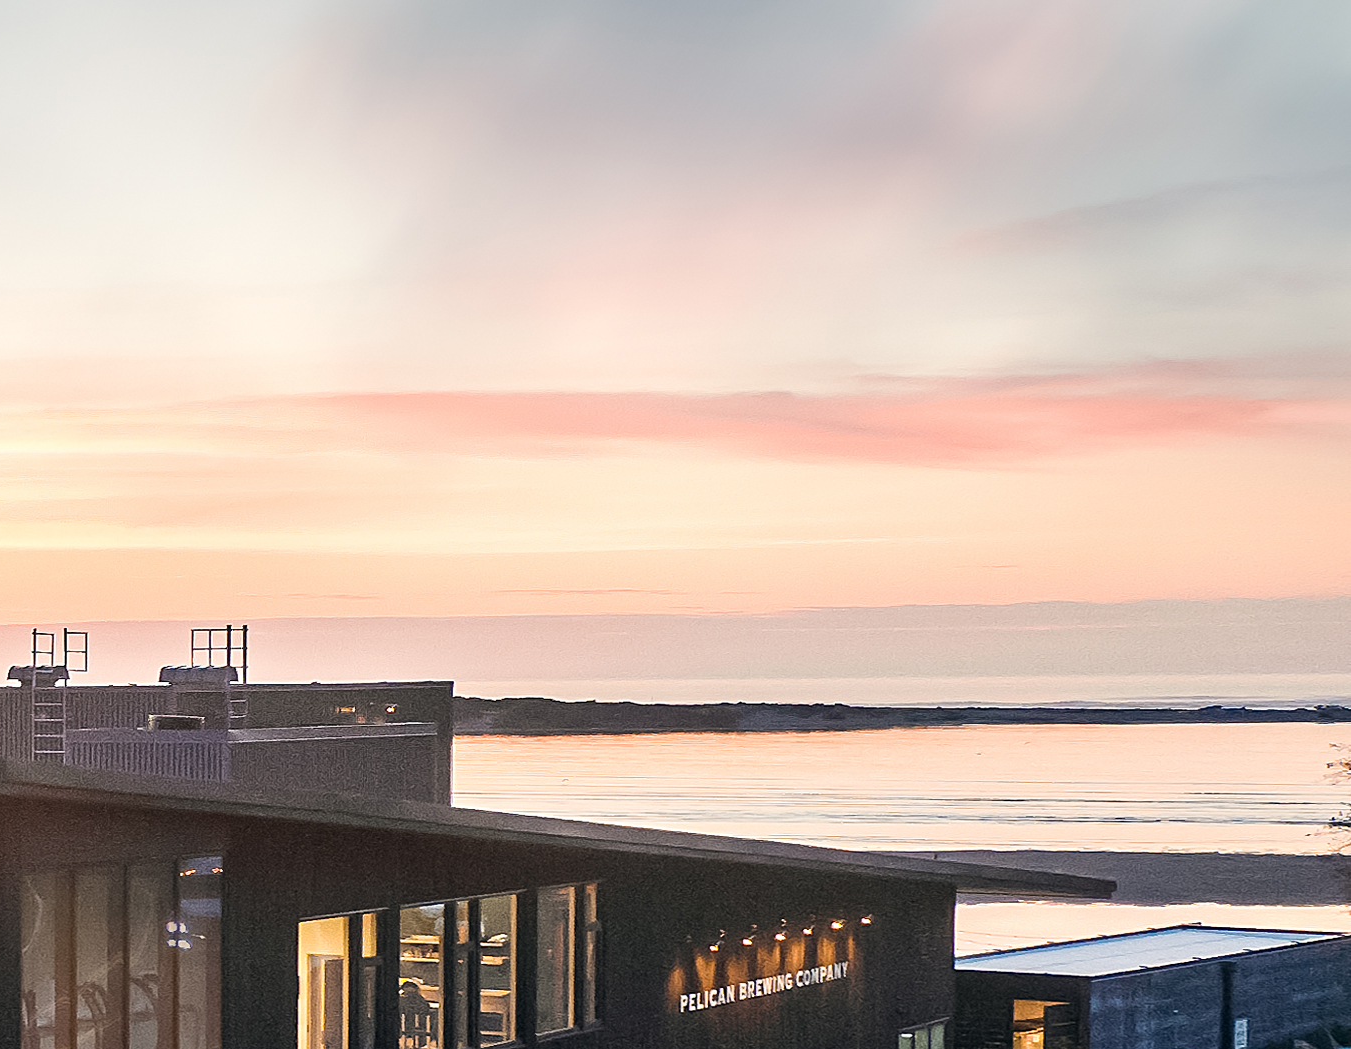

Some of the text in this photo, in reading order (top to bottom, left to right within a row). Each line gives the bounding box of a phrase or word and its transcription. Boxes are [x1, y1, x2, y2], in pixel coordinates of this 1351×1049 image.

[679, 961, 849, 1013] PELICAN BREWING COMPANY
